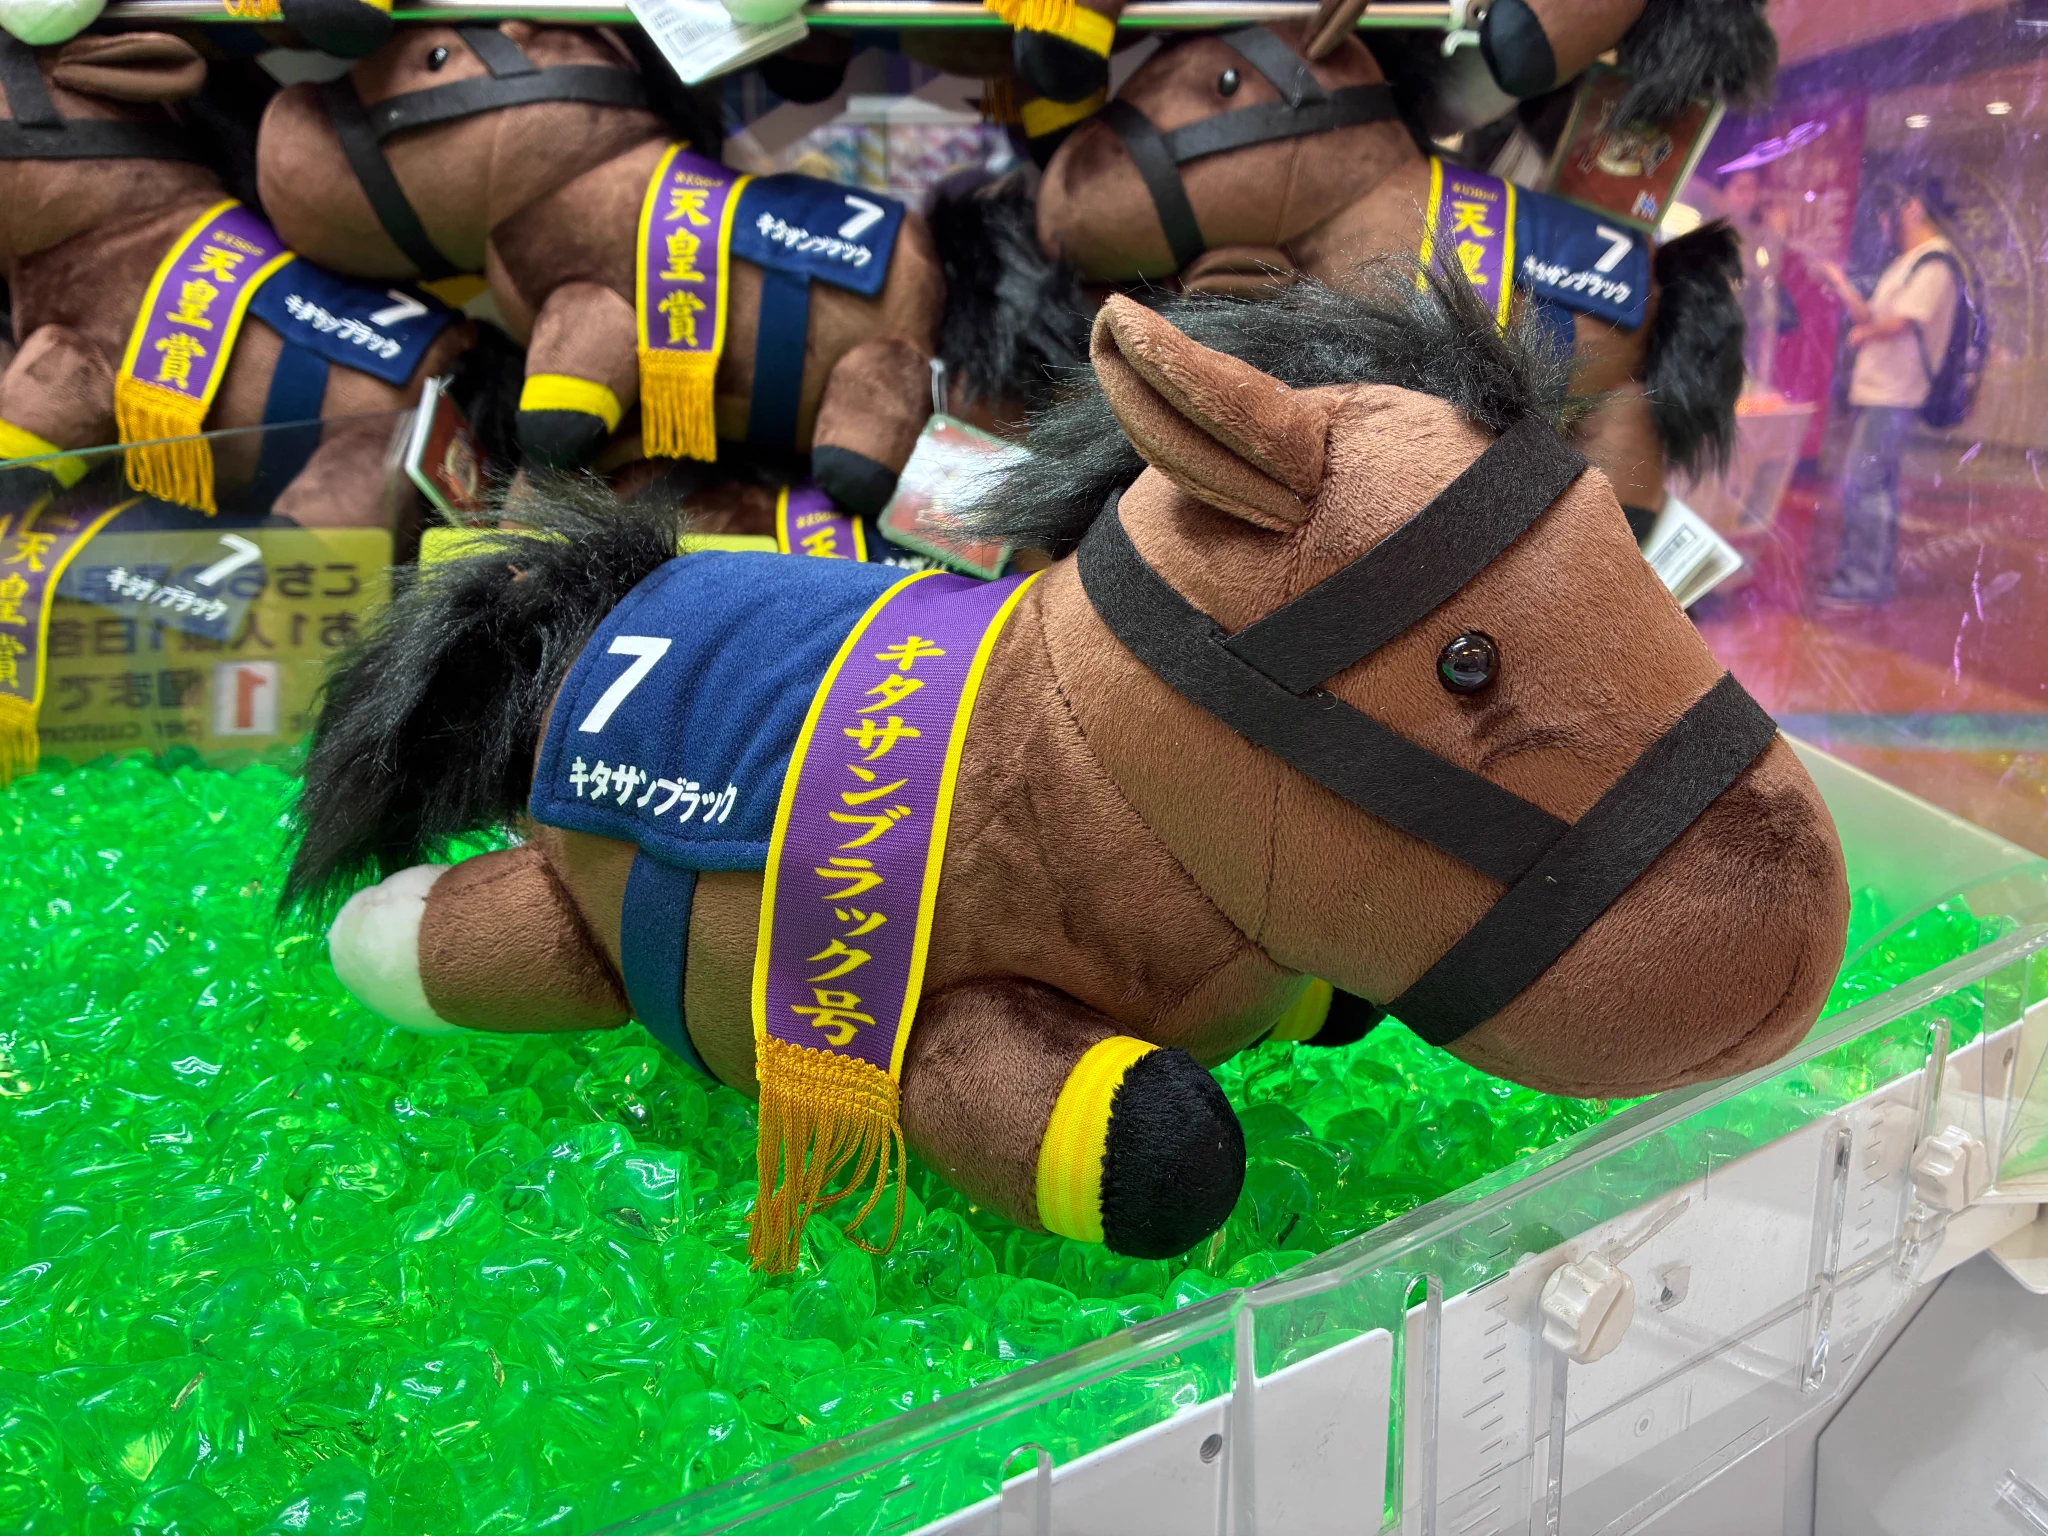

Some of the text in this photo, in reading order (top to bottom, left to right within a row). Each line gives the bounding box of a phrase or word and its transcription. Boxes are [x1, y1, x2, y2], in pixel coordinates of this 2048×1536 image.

[756, 211, 872, 268] キタサンブラック
[838, 194, 884, 239] 7
[658, 188, 712, 347] 天皇賞
[1523, 254, 1632, 304] キタサンブラック
[1594, 224, 1633, 273] 7
[155, 245, 245, 389] 天皇賞
[284, 293, 402, 359] キタサンブラック
[369, 288, 428, 327] 7
[193, 533, 263, 587] 7
[577, 635, 672, 733] 7
[568, 756, 738, 825] キタサンブラック
[790, 635, 946, 1047] キタサンブラック号
